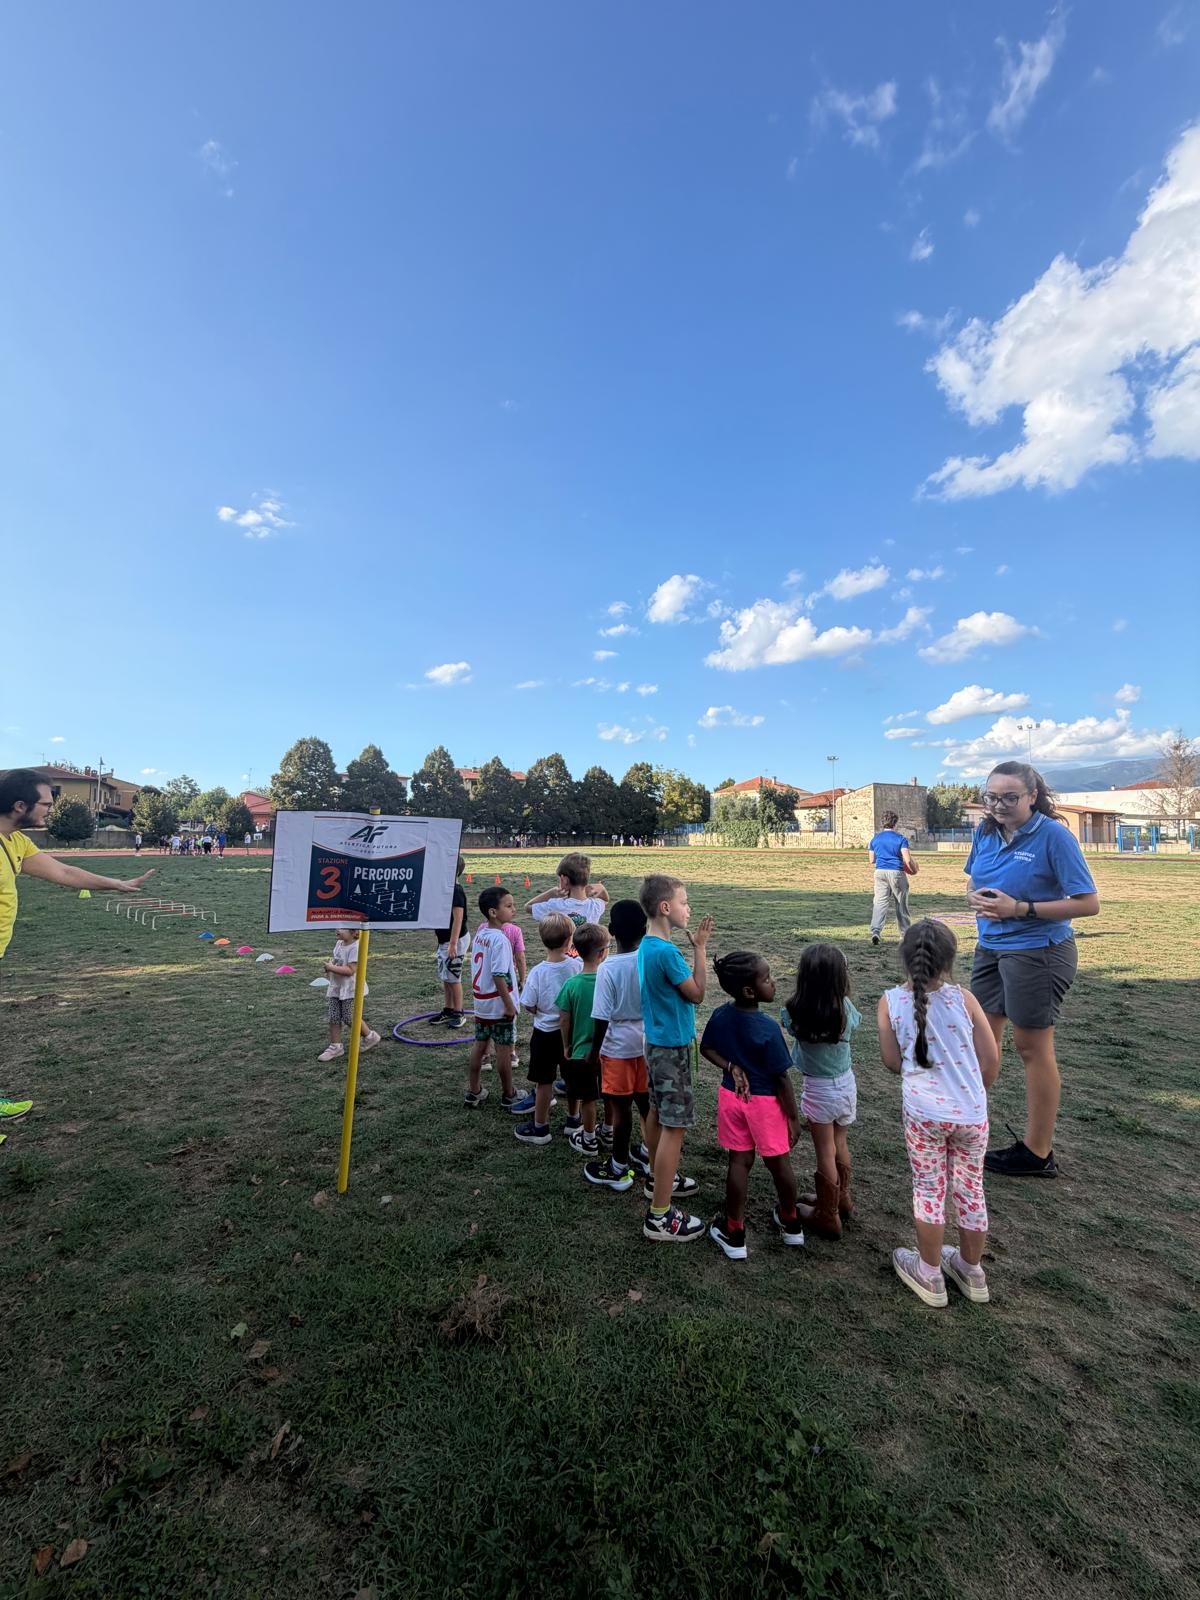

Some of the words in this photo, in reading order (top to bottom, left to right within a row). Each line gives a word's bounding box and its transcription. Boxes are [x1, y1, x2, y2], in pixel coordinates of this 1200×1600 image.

[317, 857, 348, 865] STAZIONE
[316, 866, 341, 900] 3
[353, 866, 414, 881] PERCORSO
[472, 951, 484, 992] 2
